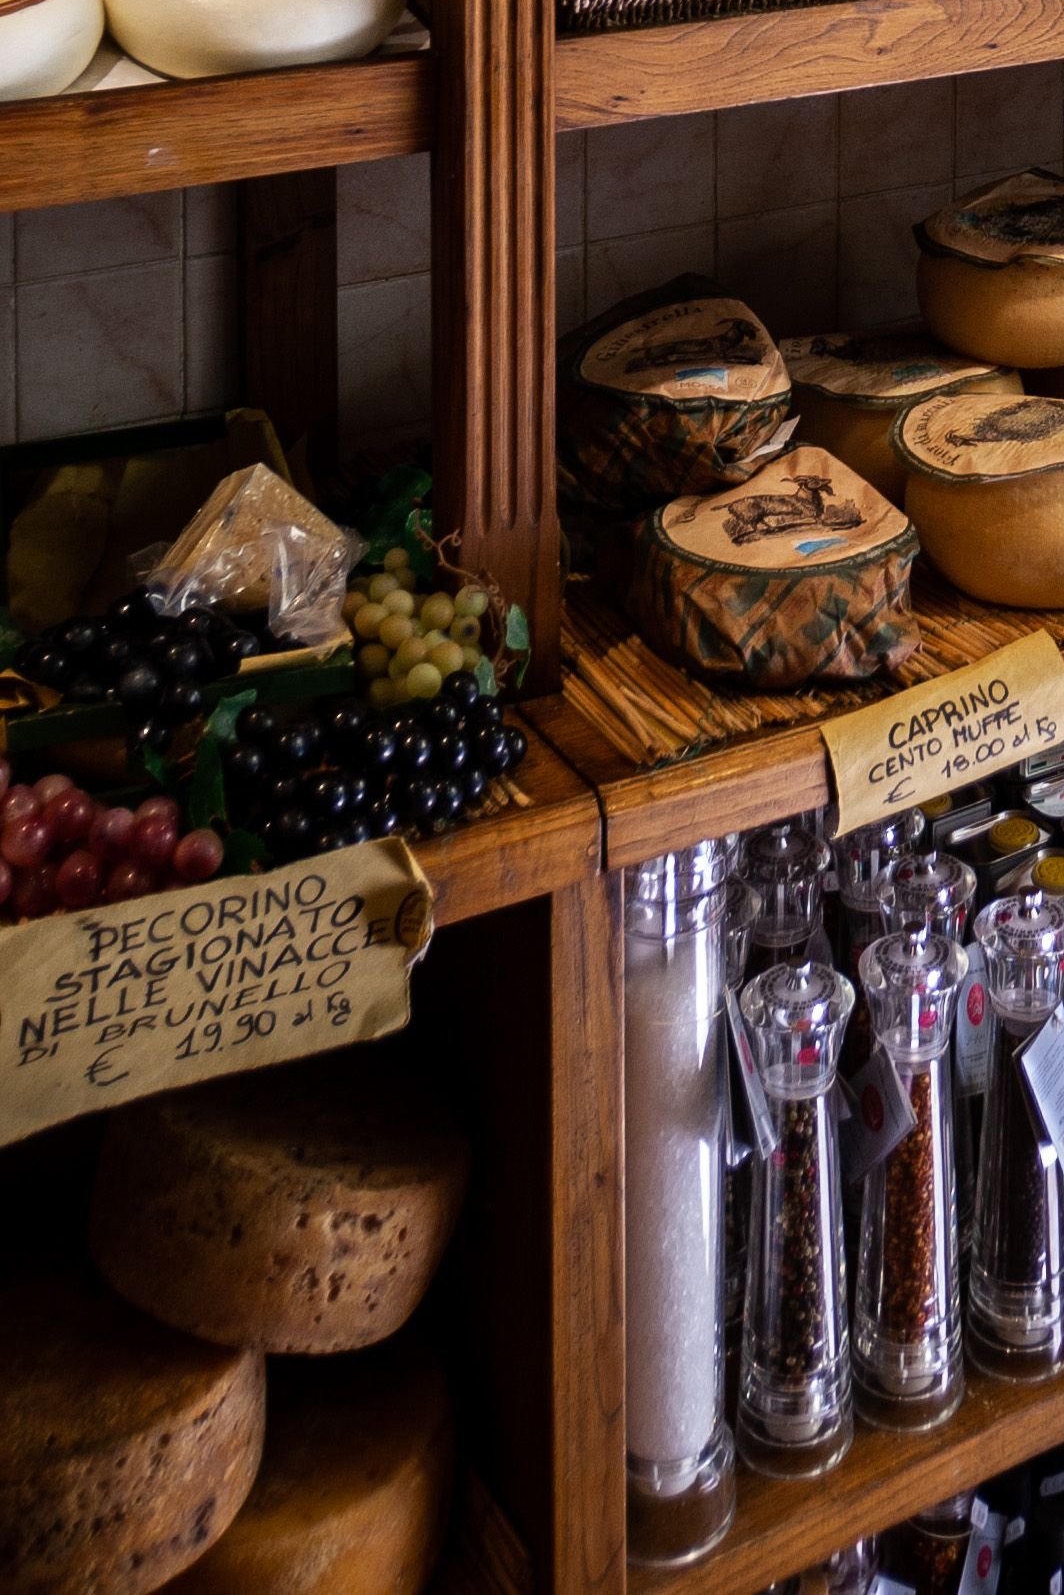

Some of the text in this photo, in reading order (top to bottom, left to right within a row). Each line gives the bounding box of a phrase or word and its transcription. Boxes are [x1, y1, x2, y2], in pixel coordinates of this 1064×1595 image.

[868, 701, 1022, 784] CENTO MUFFE
[889, 679, 1009, 749] CAPRINO
[883, 777, 916, 804] €
[1012, 724, 1030, 747] al
[46, 894, 366, 1002] STAGIONATO
[83, 874, 327, 961] PECORINO
[18, 917, 391, 1047] NELLE VINACCE
[18, 961, 351, 1067] DI BRUNELLO
[84, 1045, 130, 1087] €
[291, 1000, 313, 1027] al
